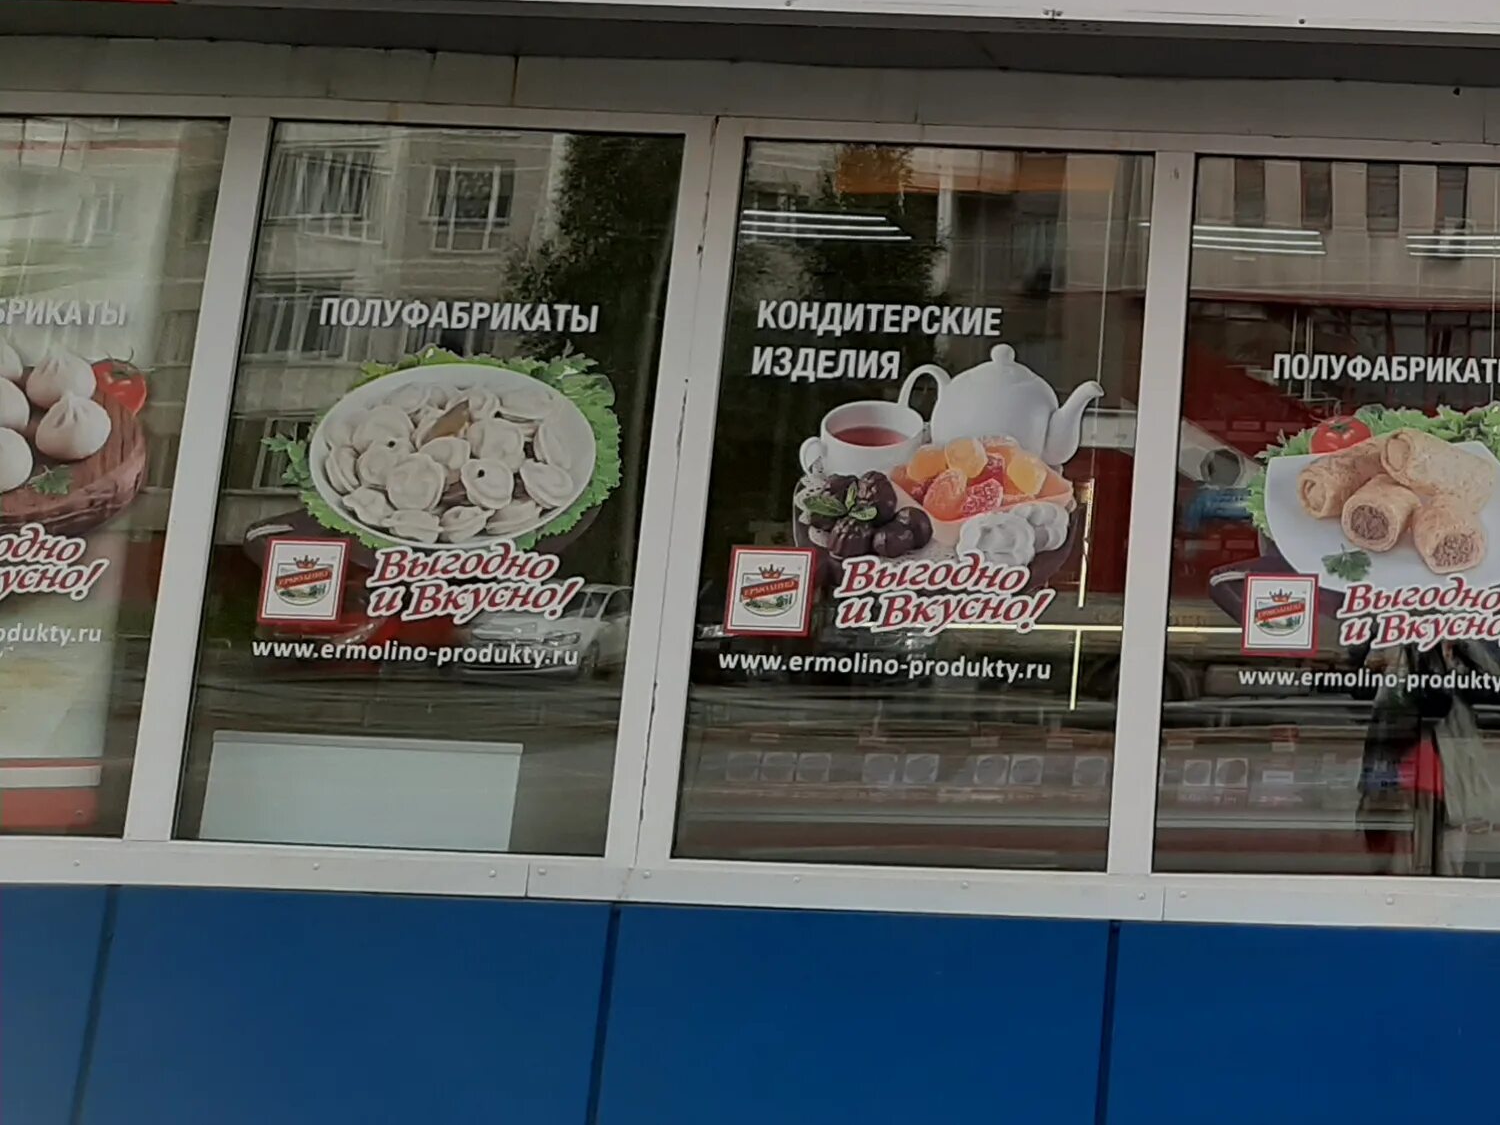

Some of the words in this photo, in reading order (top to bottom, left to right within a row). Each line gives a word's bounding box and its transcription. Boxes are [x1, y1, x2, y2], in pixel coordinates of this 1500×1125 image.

[319, 297, 600, 333] ПОЛУФАБРИКАТЫ
[757, 300, 1003, 336] КОНДИТЕРСКИЕ
[751, 346, 900, 381] ИЗДЕЛИЯ
[373, 542, 558, 583] Выгодно
[840, 553, 1028, 595] Выгодно
[371, 588, 402, 614] и
[406, 579, 582, 623] Вкусно!
[839, 600, 871, 626] и
[874, 591, 1055, 635] Вкусно!
[1341, 620, 1372, 645] и
[252, 639, 579, 667] www.ermolino-produkty.ru
[718, 651, 1051, 681] www.ermolino-produkty.ru
